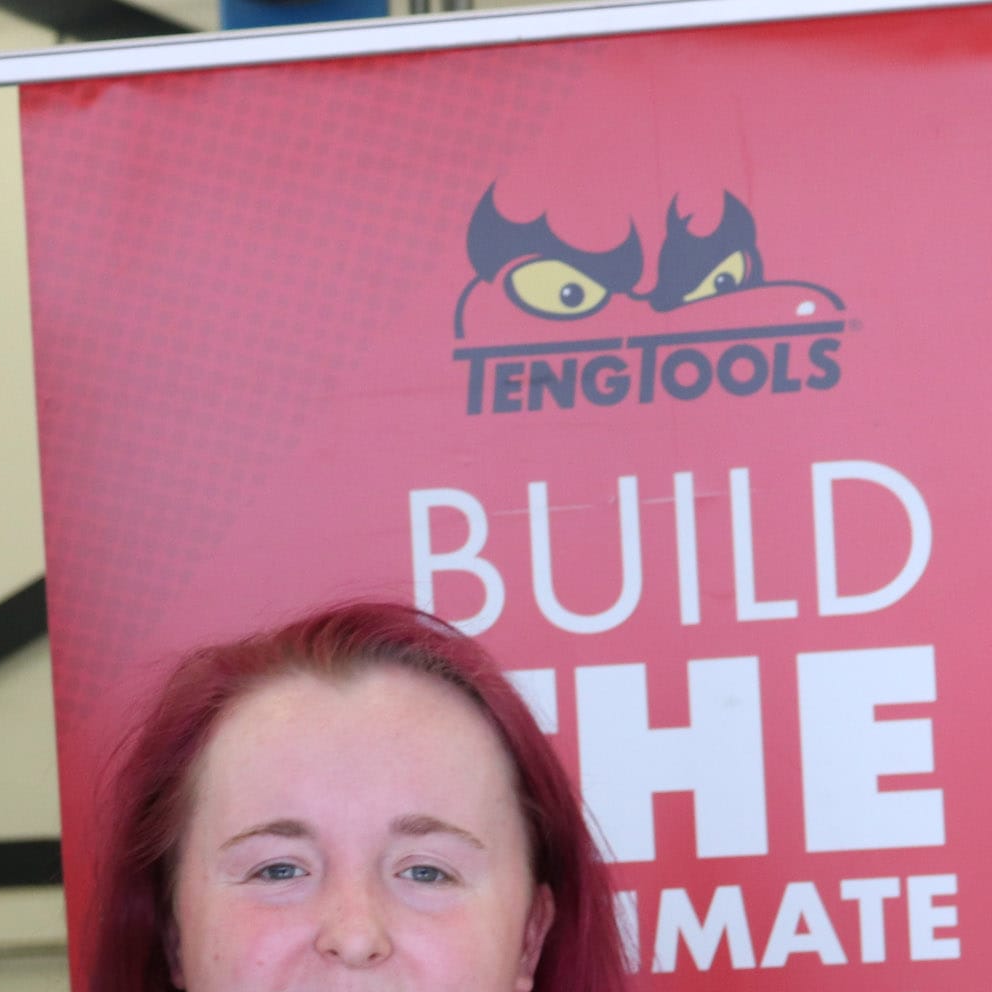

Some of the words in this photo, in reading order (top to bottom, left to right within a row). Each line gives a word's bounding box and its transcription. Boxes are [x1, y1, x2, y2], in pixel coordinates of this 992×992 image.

[452, 321, 846, 416] TENGTOOLS
[409, 460, 932, 637] BUILD
[505, 645, 946, 863] HE
